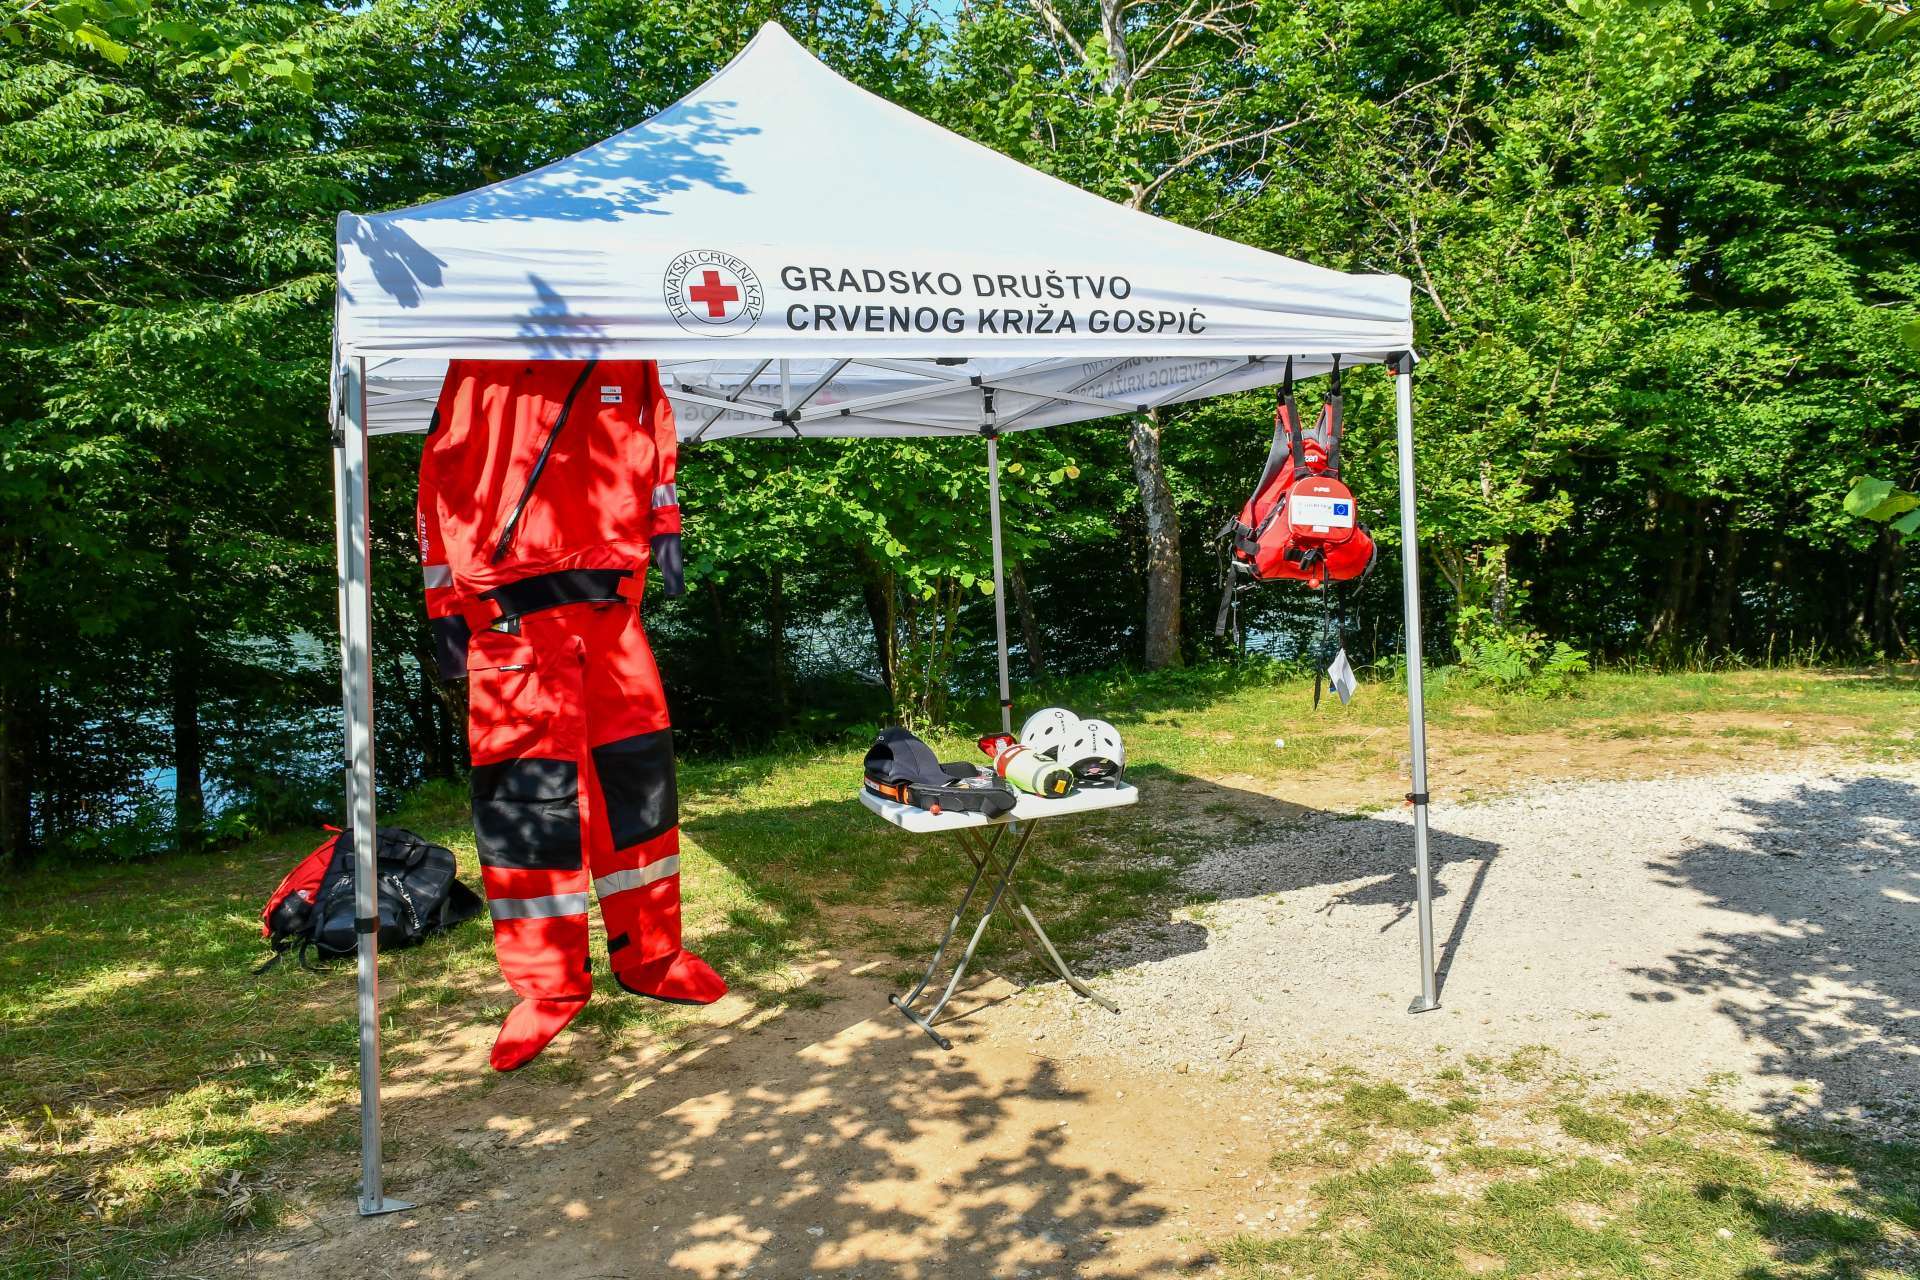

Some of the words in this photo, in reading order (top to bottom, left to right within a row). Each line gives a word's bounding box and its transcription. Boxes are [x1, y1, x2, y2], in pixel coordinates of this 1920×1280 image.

[667, 254, 697, 318] HRVATSKI
[698, 251, 755, 282] CRVENI
[743, 284, 760, 322] KRIŽ
[780, 265, 962, 297] GRADSKO
[972, 270, 1131, 300] DRUŠTVO
[786, 303, 965, 333] CRVENOG
[978, 303, 1077, 334] KRIŽA
